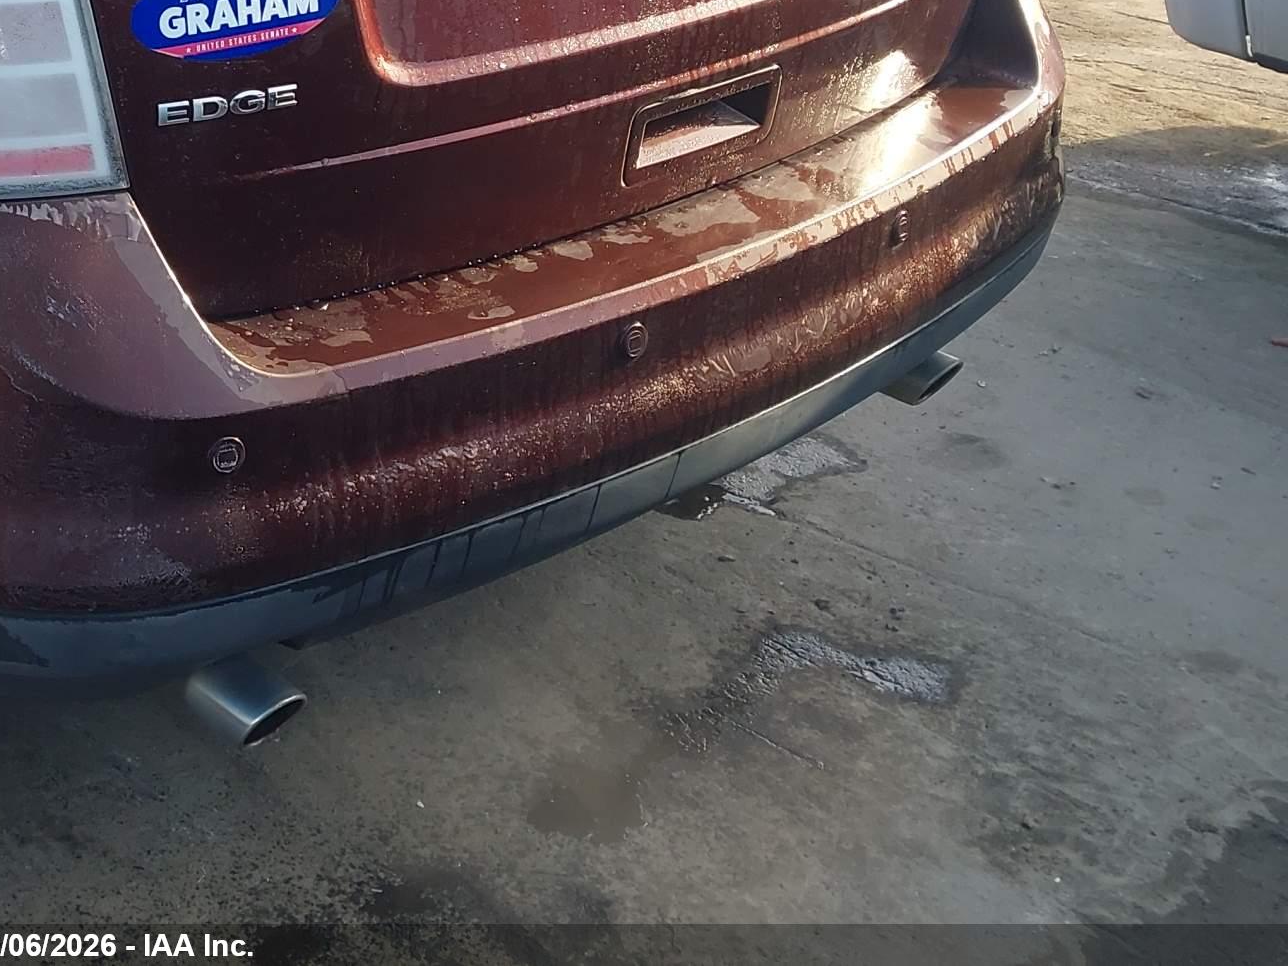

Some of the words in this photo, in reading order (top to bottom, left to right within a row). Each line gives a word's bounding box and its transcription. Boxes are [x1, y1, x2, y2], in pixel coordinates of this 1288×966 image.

[196, 40, 225, 52] UNITED
[228, 34, 257, 47] STATES
[260, 27, 289, 40] SENATE
[157, 83, 298, 126] EDGE
